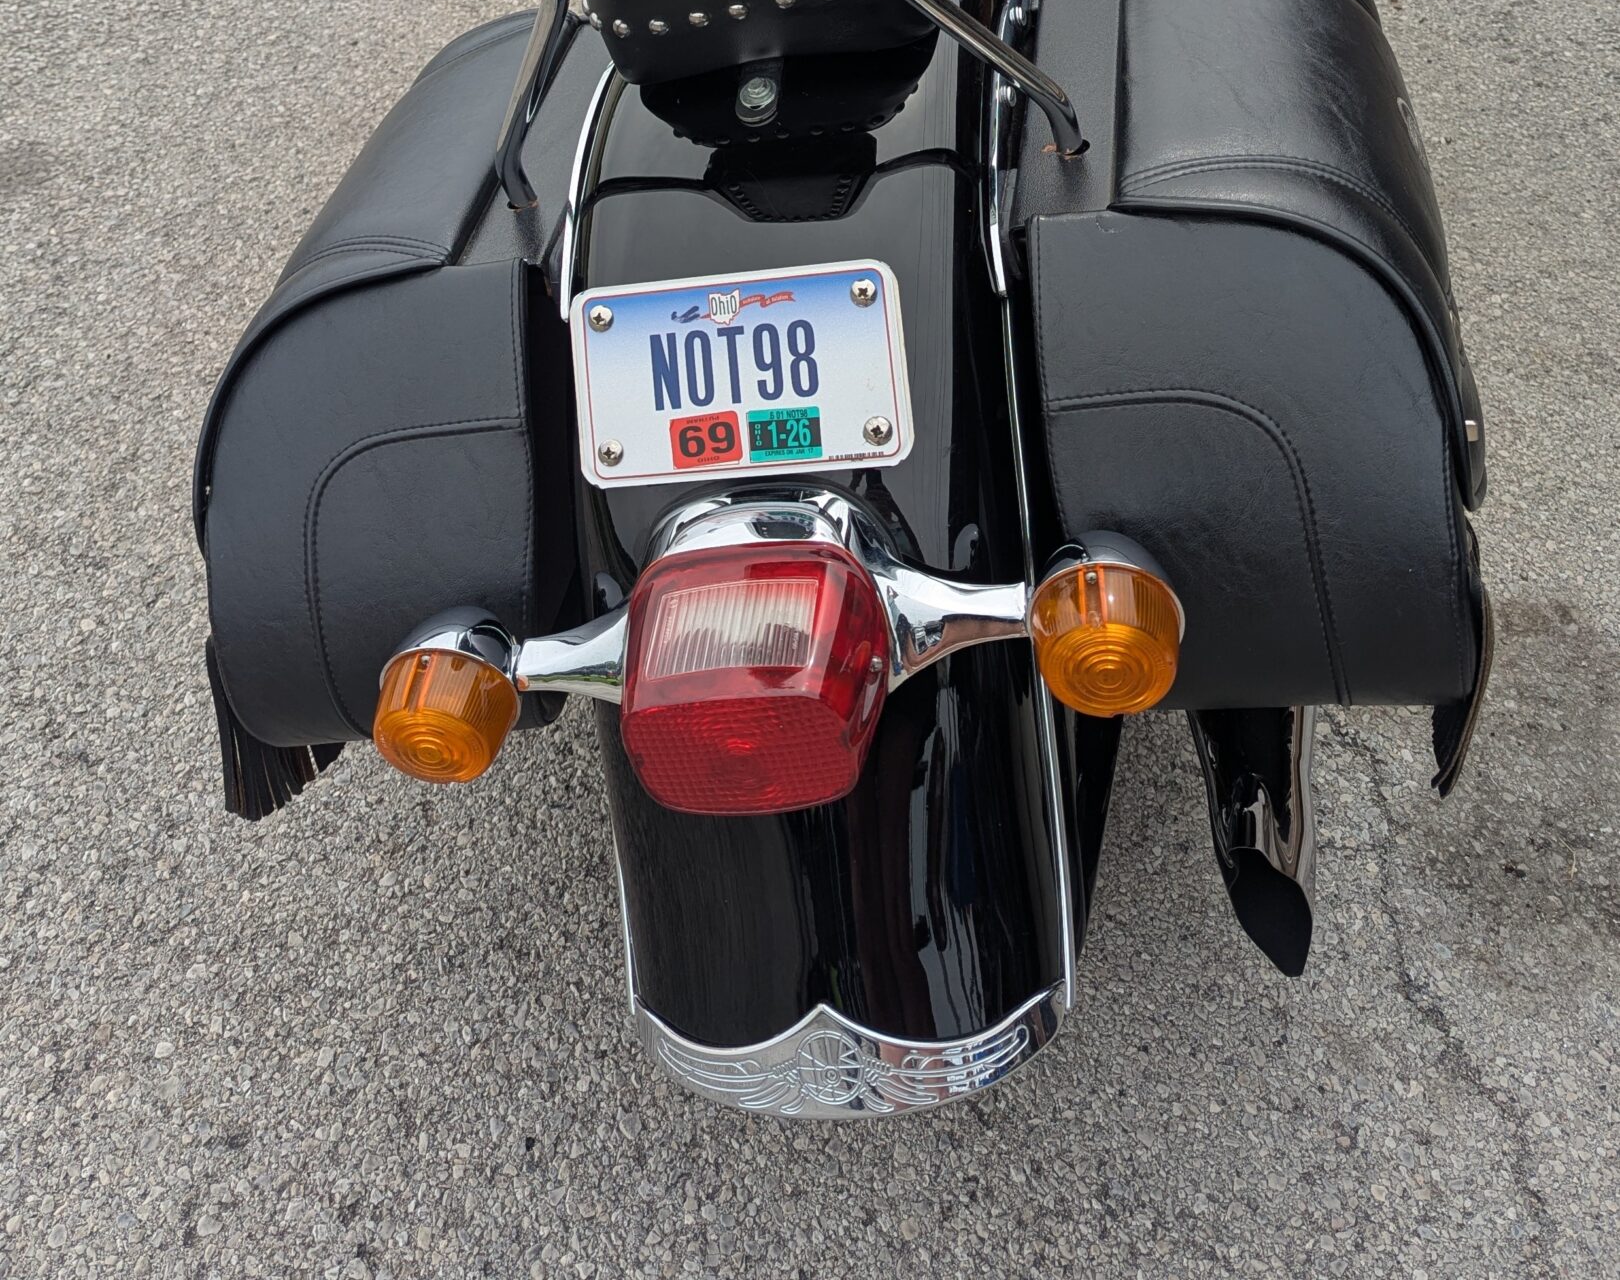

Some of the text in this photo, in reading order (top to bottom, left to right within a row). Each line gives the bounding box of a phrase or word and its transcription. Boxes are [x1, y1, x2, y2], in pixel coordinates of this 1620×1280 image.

[711, 294, 738, 316] Ohio
[650, 319, 819, 411] NOT98
[679, 421, 736, 458] 69
[754, 423, 762, 446] OHIO
[767, 419, 811, 448] 1-26
